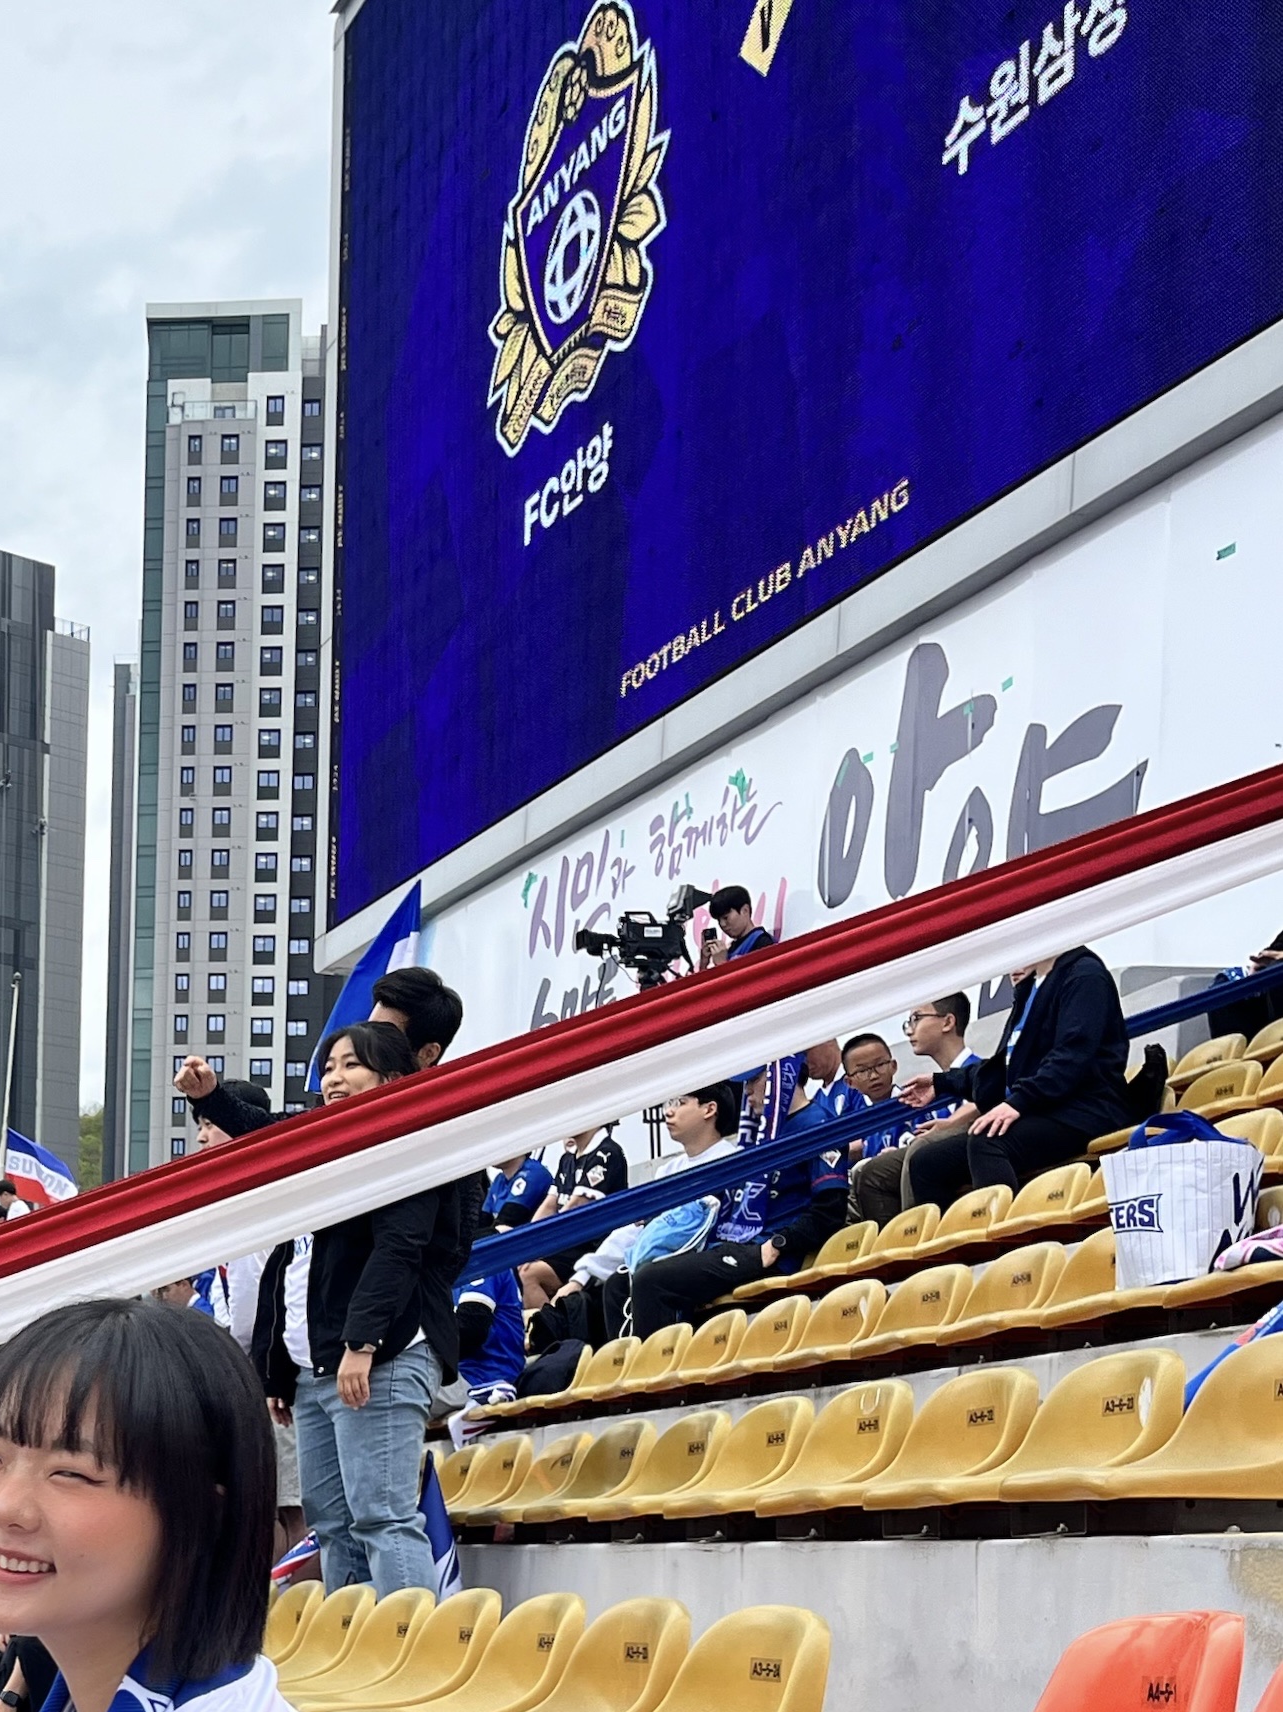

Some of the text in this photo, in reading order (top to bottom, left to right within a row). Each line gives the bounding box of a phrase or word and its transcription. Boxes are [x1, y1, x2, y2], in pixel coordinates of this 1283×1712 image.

[527, 95, 626, 237] ANYANG
[523, 420, 613, 547] FC안양
[619, 476, 910, 698] FOOTBALL CLUB ANYANG
[1111, 1199, 1155, 1229] ERS
